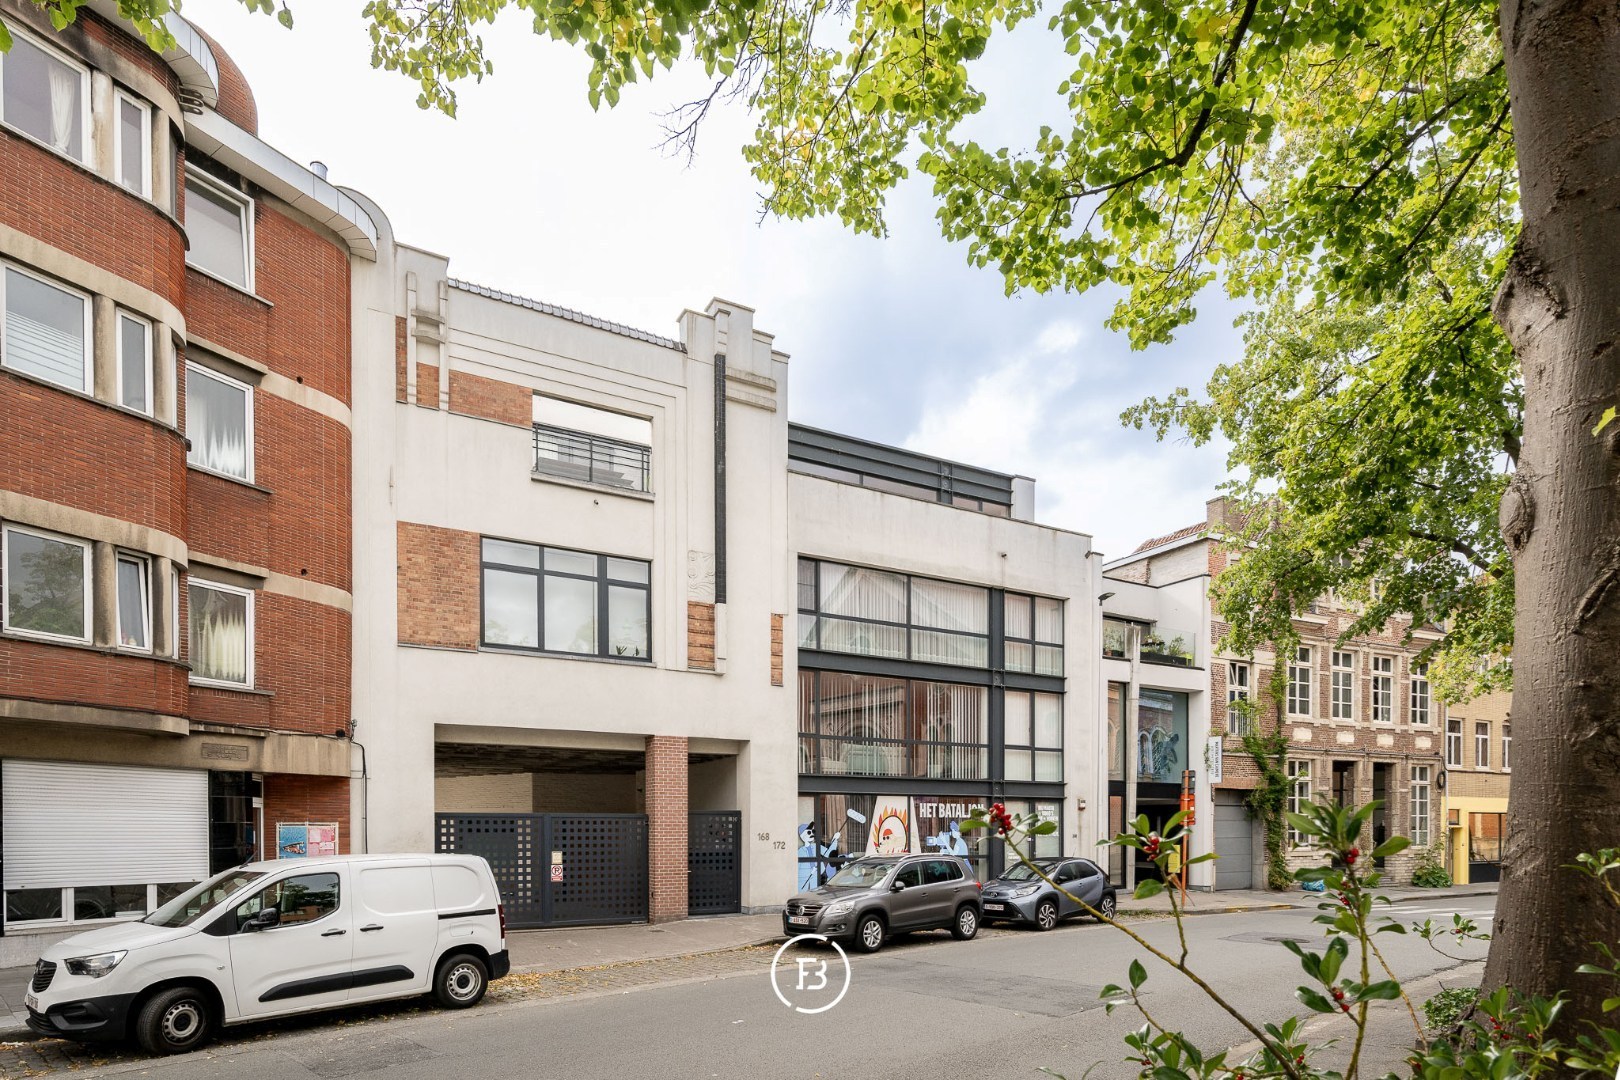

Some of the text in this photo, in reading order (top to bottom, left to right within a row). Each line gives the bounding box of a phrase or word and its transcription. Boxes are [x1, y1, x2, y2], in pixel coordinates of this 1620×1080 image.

[919, 803, 937, 818] HET
[757, 832, 770, 841] 168
[772, 841, 786, 850] 172
